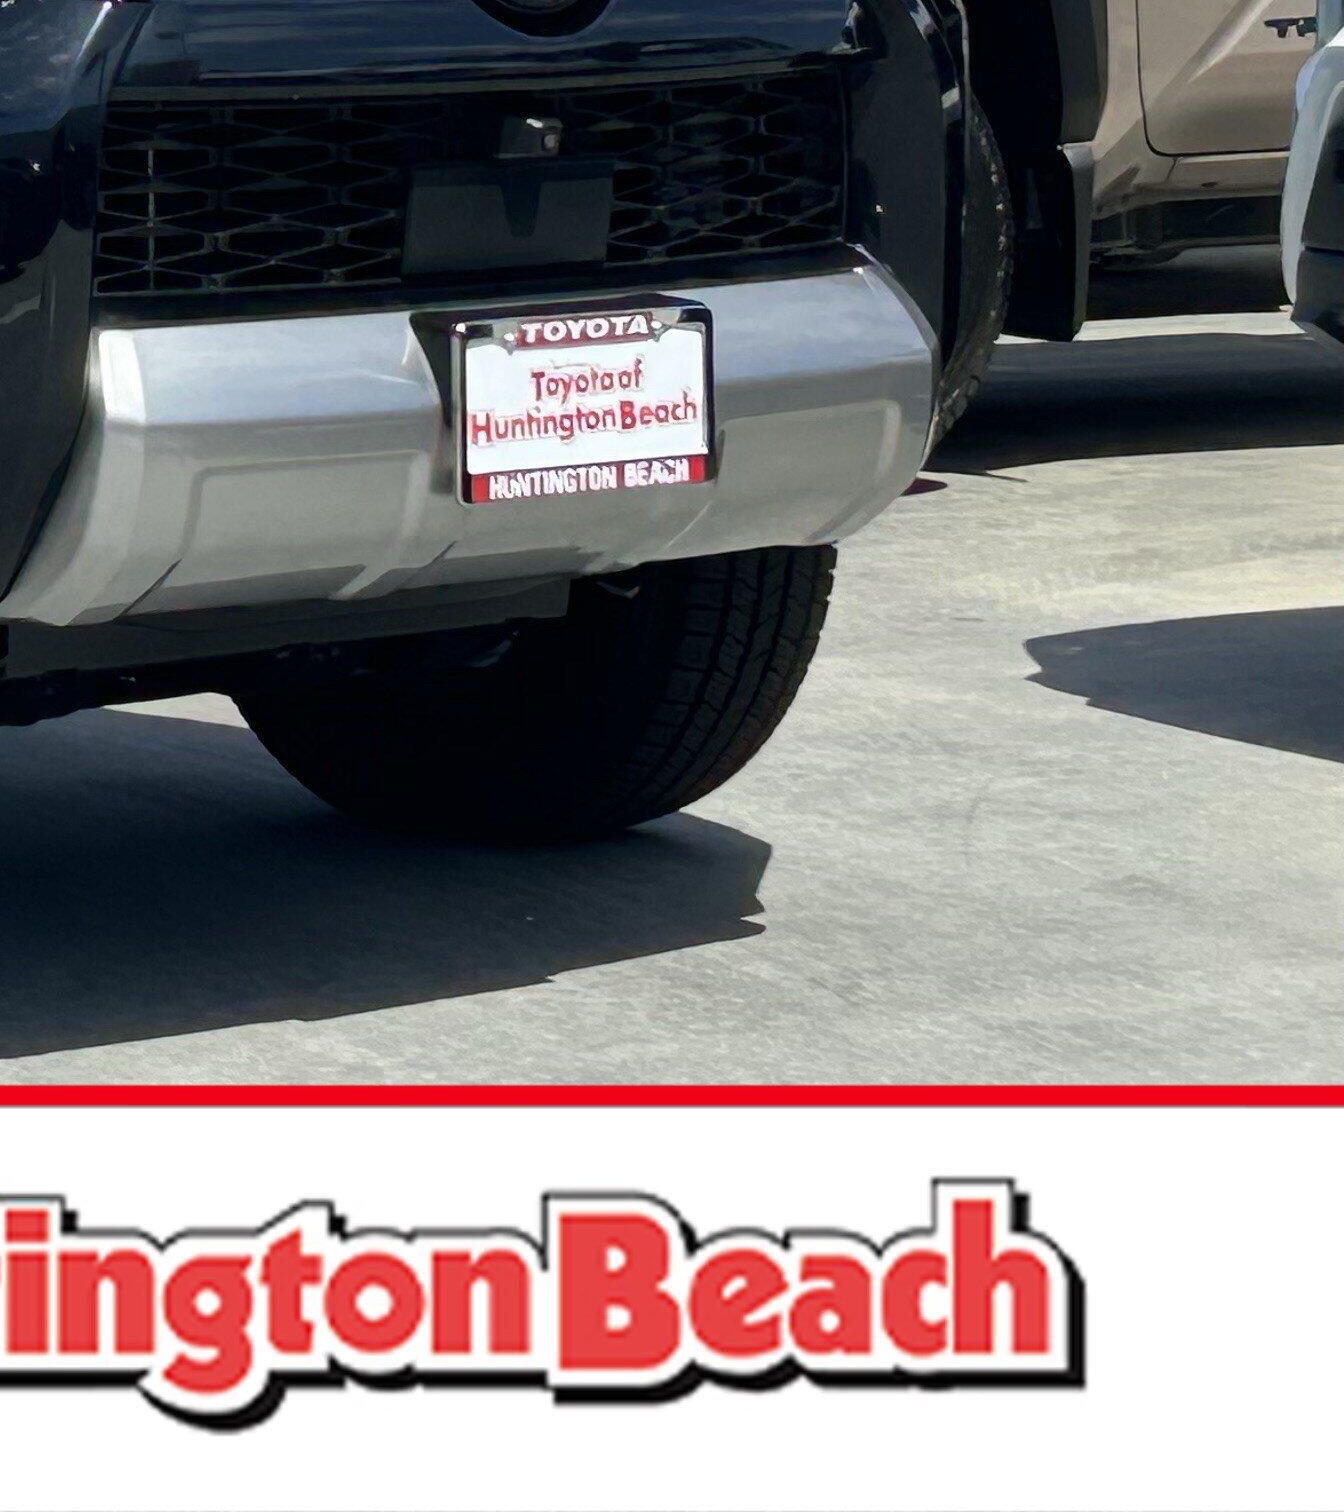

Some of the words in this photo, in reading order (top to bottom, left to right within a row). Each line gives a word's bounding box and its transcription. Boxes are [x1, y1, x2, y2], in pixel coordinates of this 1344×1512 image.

[520, 314, 650, 344] TOYOTA
[530, 367, 614, 403] Toyota
[618, 357, 643, 388] of
[469, 404, 616, 444] Huntington
[619, 390, 698, 430] Beach
[488, 464, 617, 500] HUNTINGTON
[623, 458, 690, 486] BEACH
